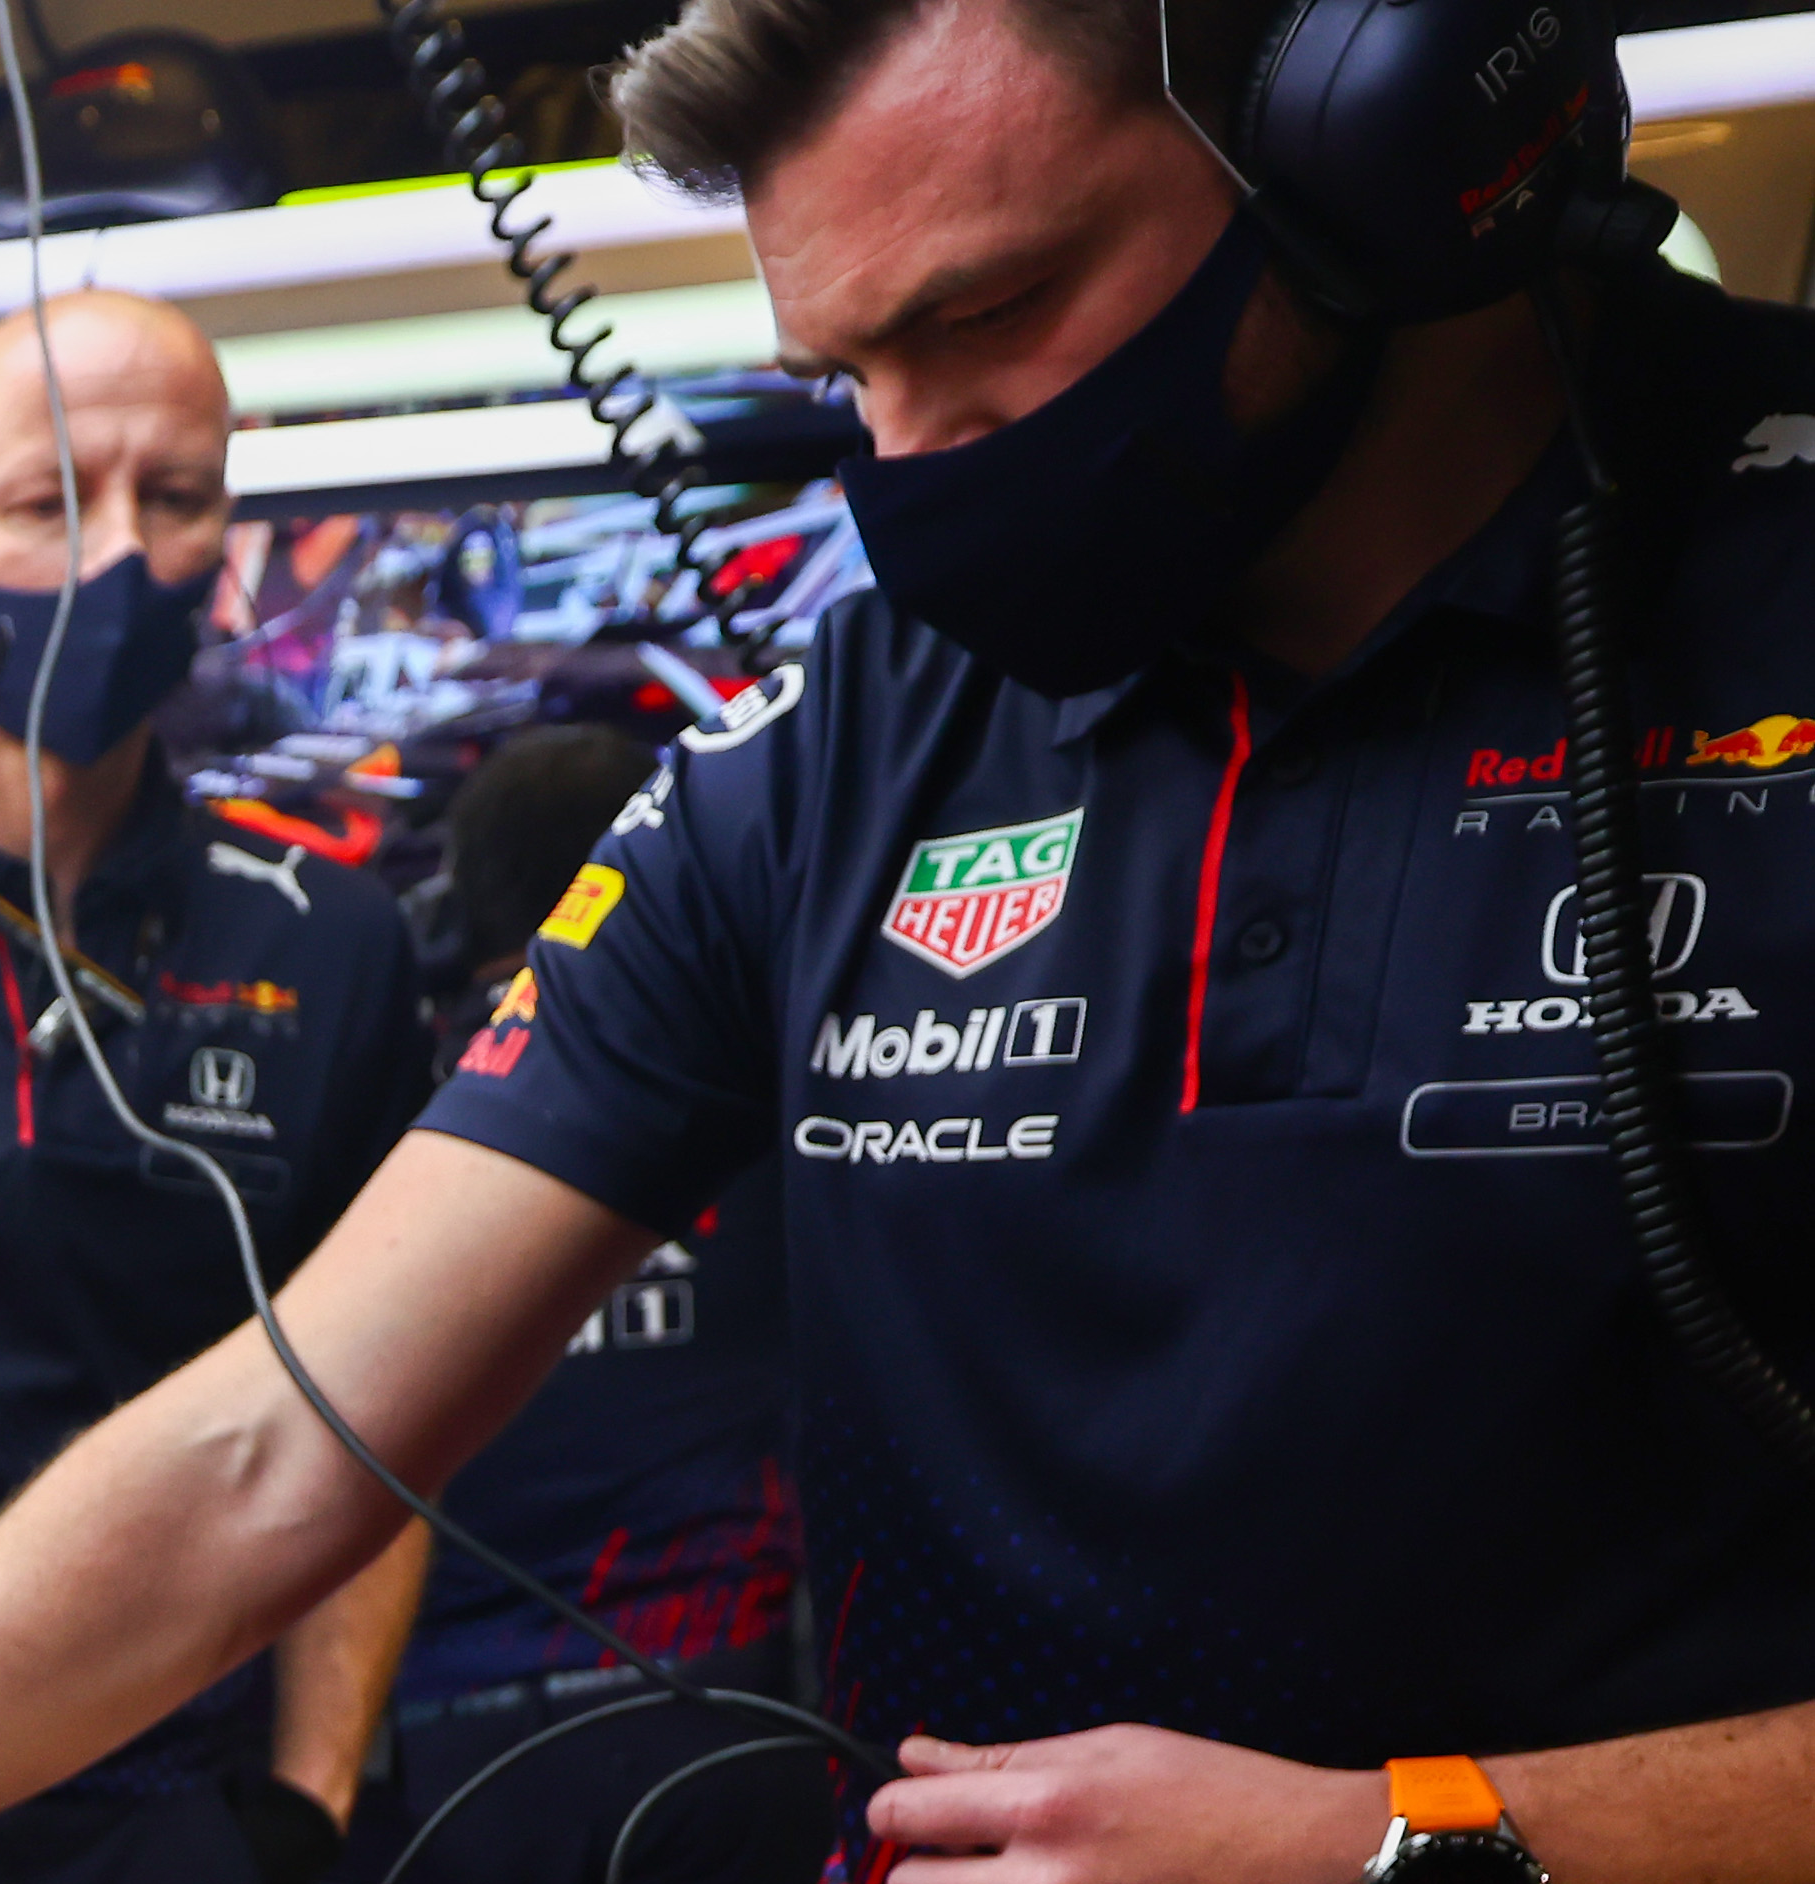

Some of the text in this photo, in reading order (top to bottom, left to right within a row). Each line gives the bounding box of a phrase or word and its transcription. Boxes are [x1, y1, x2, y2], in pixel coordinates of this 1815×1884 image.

[1466, 739, 1568, 787] Red
[1454, 777, 1815, 838] RAIN
[926, 830, 1071, 890] TAG
[893, 884, 1061, 962] HEUER
[1462, 987, 1760, 1035] HODA
[810, 1004, 1058, 1080] Mobil 1
[794, 1113, 1061, 1165] ORACLE
